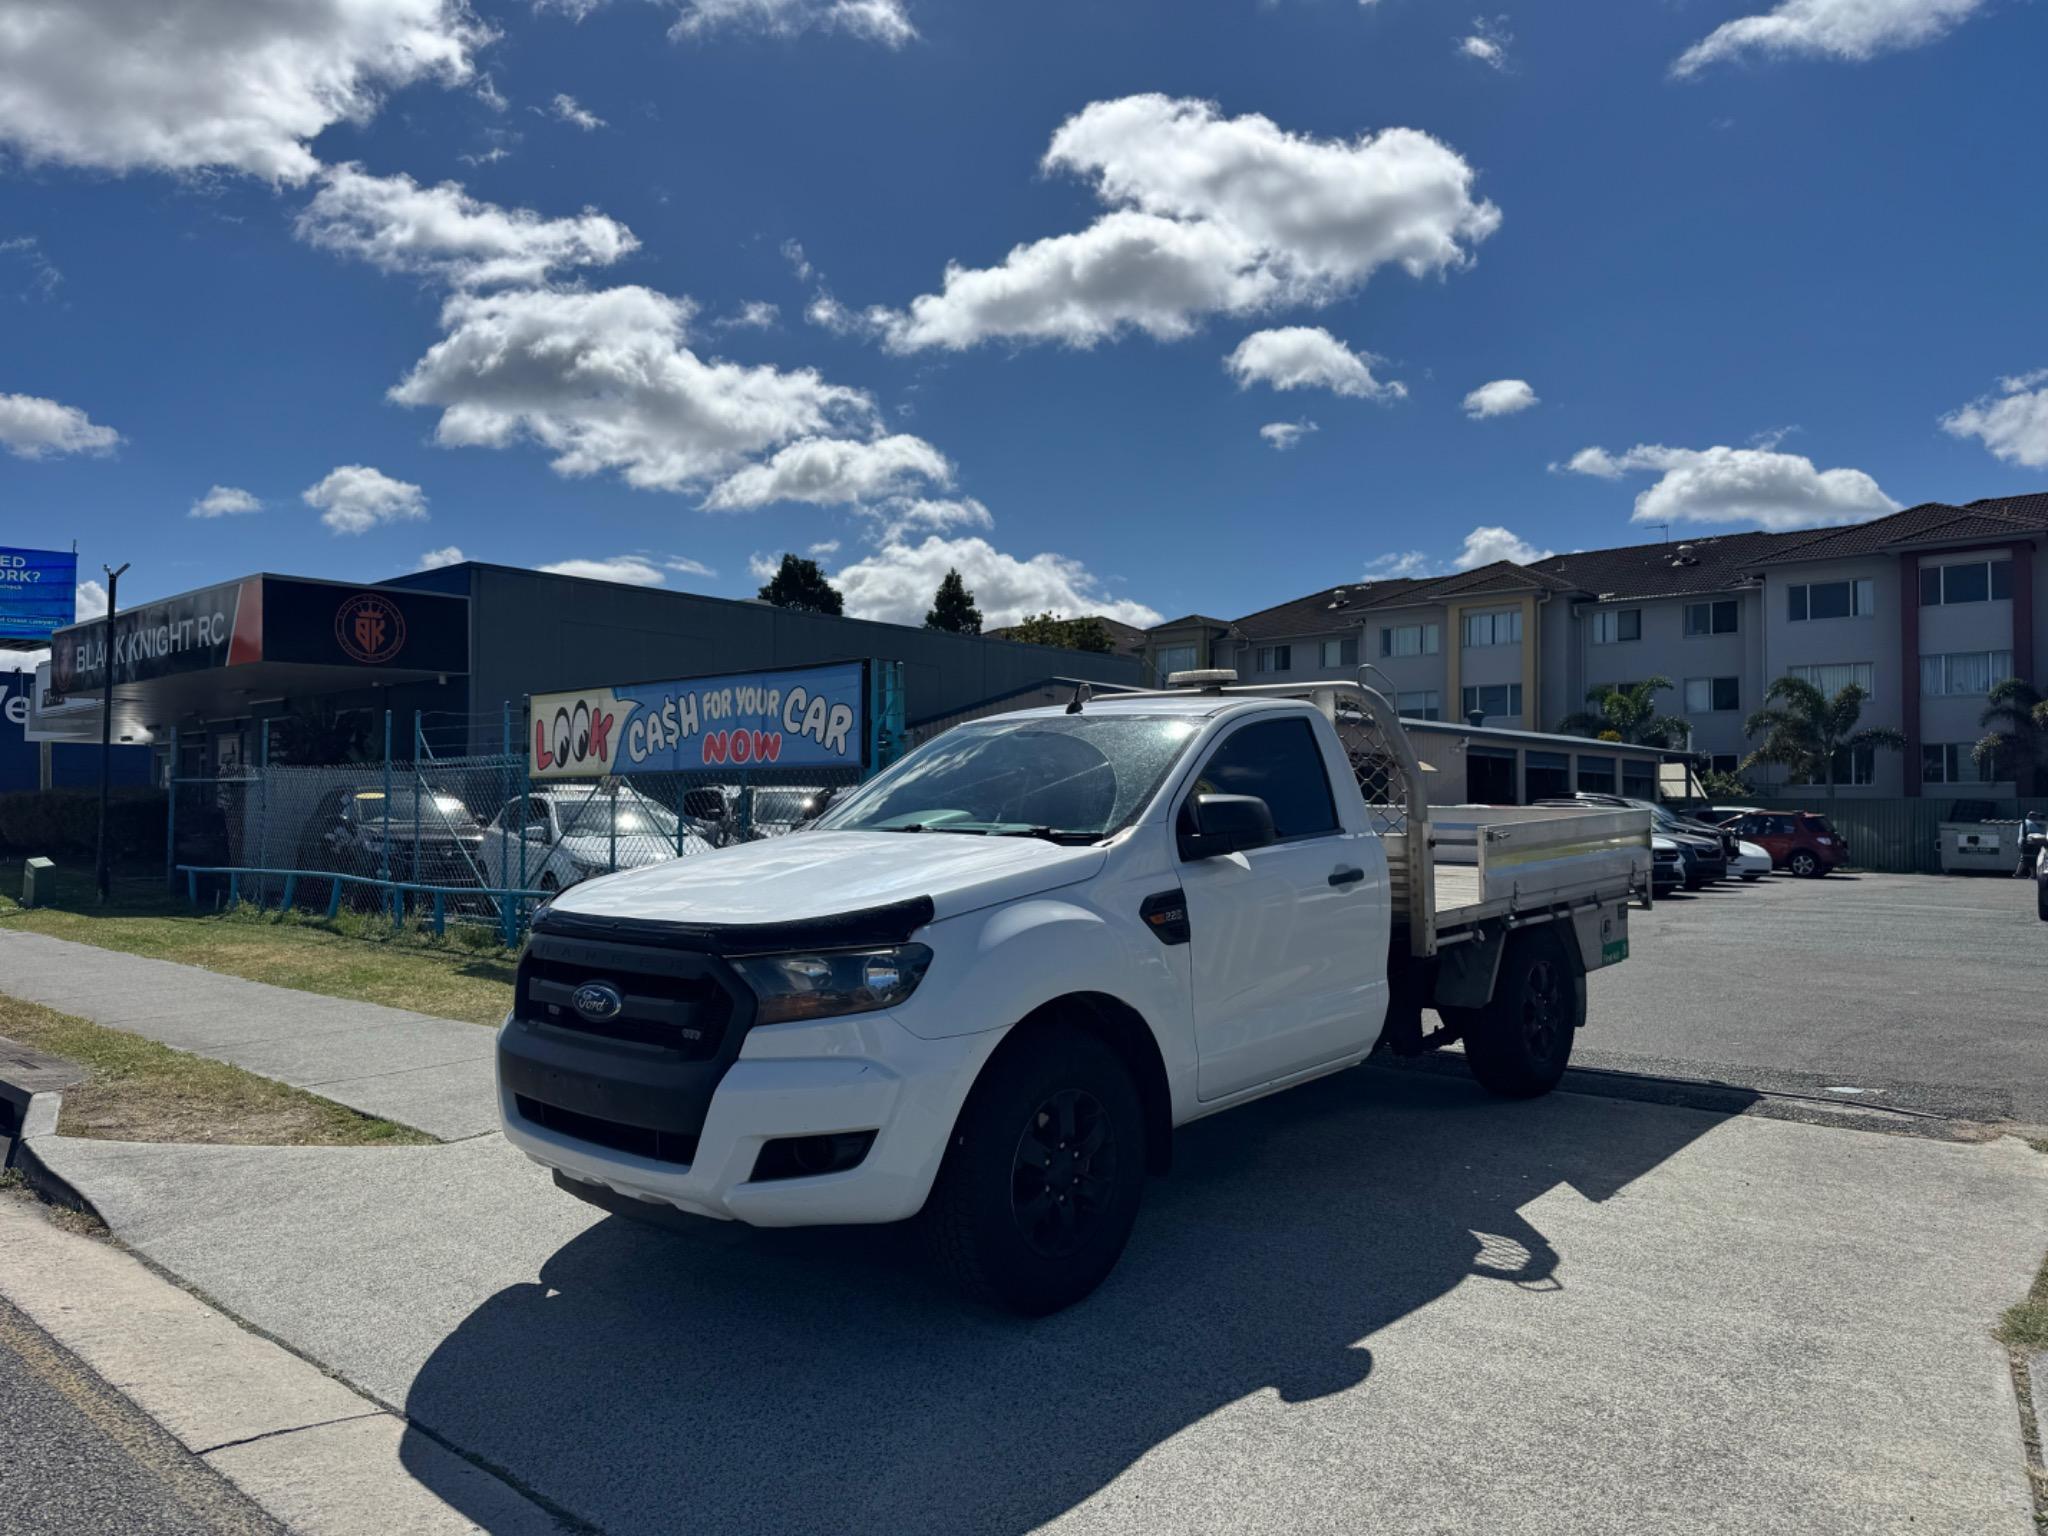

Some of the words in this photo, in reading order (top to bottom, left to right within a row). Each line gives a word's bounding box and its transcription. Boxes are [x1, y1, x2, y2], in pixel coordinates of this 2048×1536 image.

[76, 635, 125, 673] BLAK
[128, 619, 193, 662] KNIGHT
[198, 612, 225, 647] RC
[536, 699, 614, 770] LOOK
[702, 688, 732, 721] FOR
[735, 686, 780, 717] YOUR
[782, 685, 853, 756] CAR
[702, 728, 782, 765] NOW
[578, 989, 609, 1012] Ford
